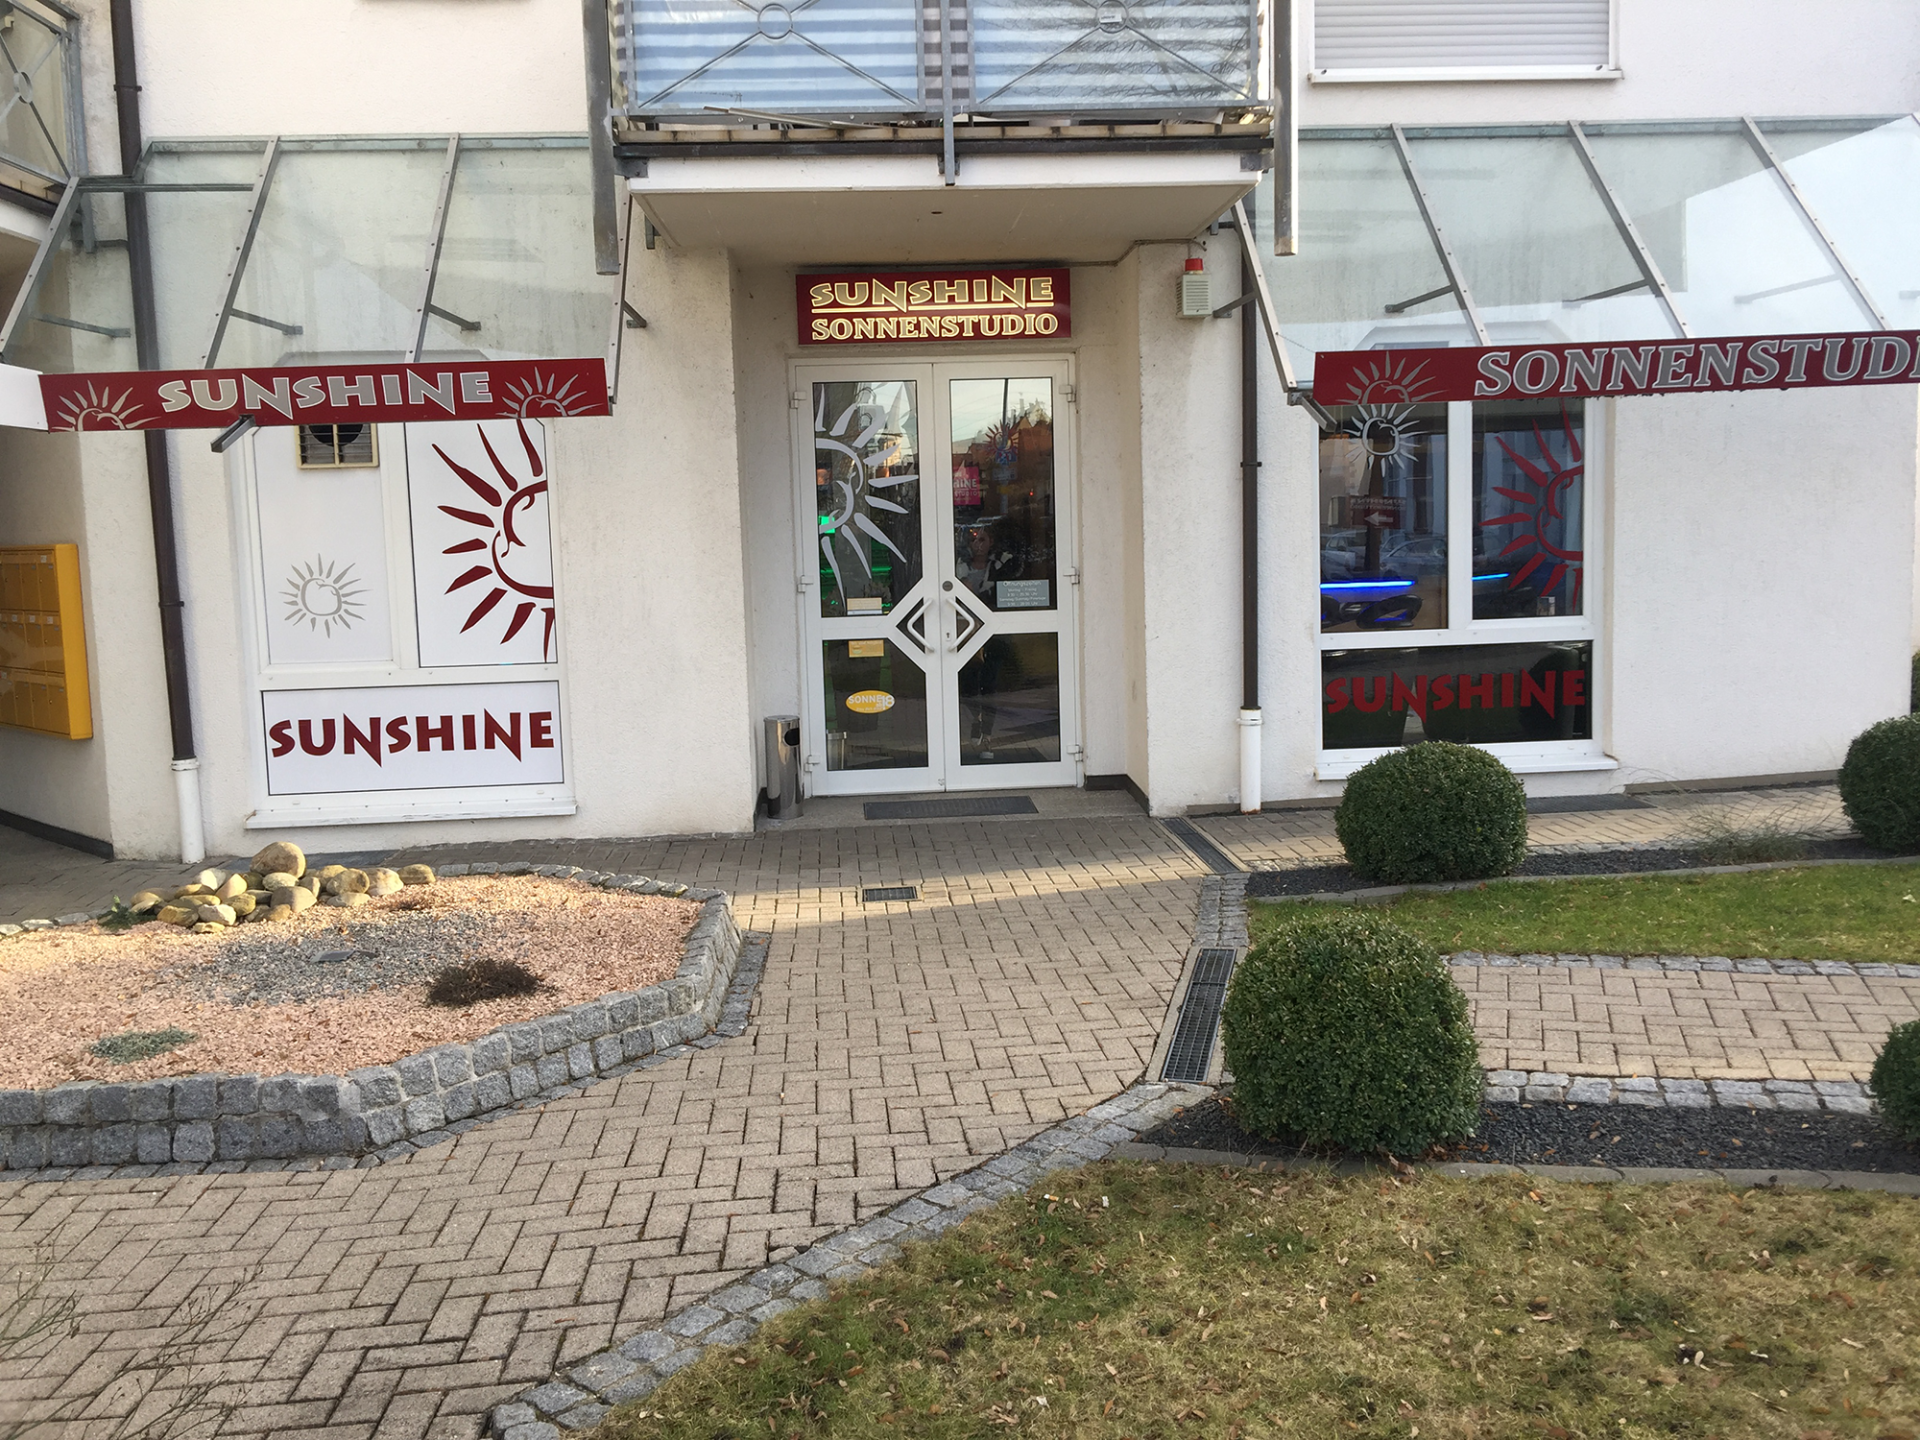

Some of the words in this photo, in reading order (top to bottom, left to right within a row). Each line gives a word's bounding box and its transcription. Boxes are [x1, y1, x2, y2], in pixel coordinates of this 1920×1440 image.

[809, 275, 1054, 312] SUNSHINE
[811, 313, 1059, 341] SONNENSTUDIO
[157, 367, 493, 420] SUNSHINE
[848, 694, 883, 704] SONNE
[1325, 668, 1586, 724] SUNSHINE
[268, 708, 555, 767] SUNSHINE
